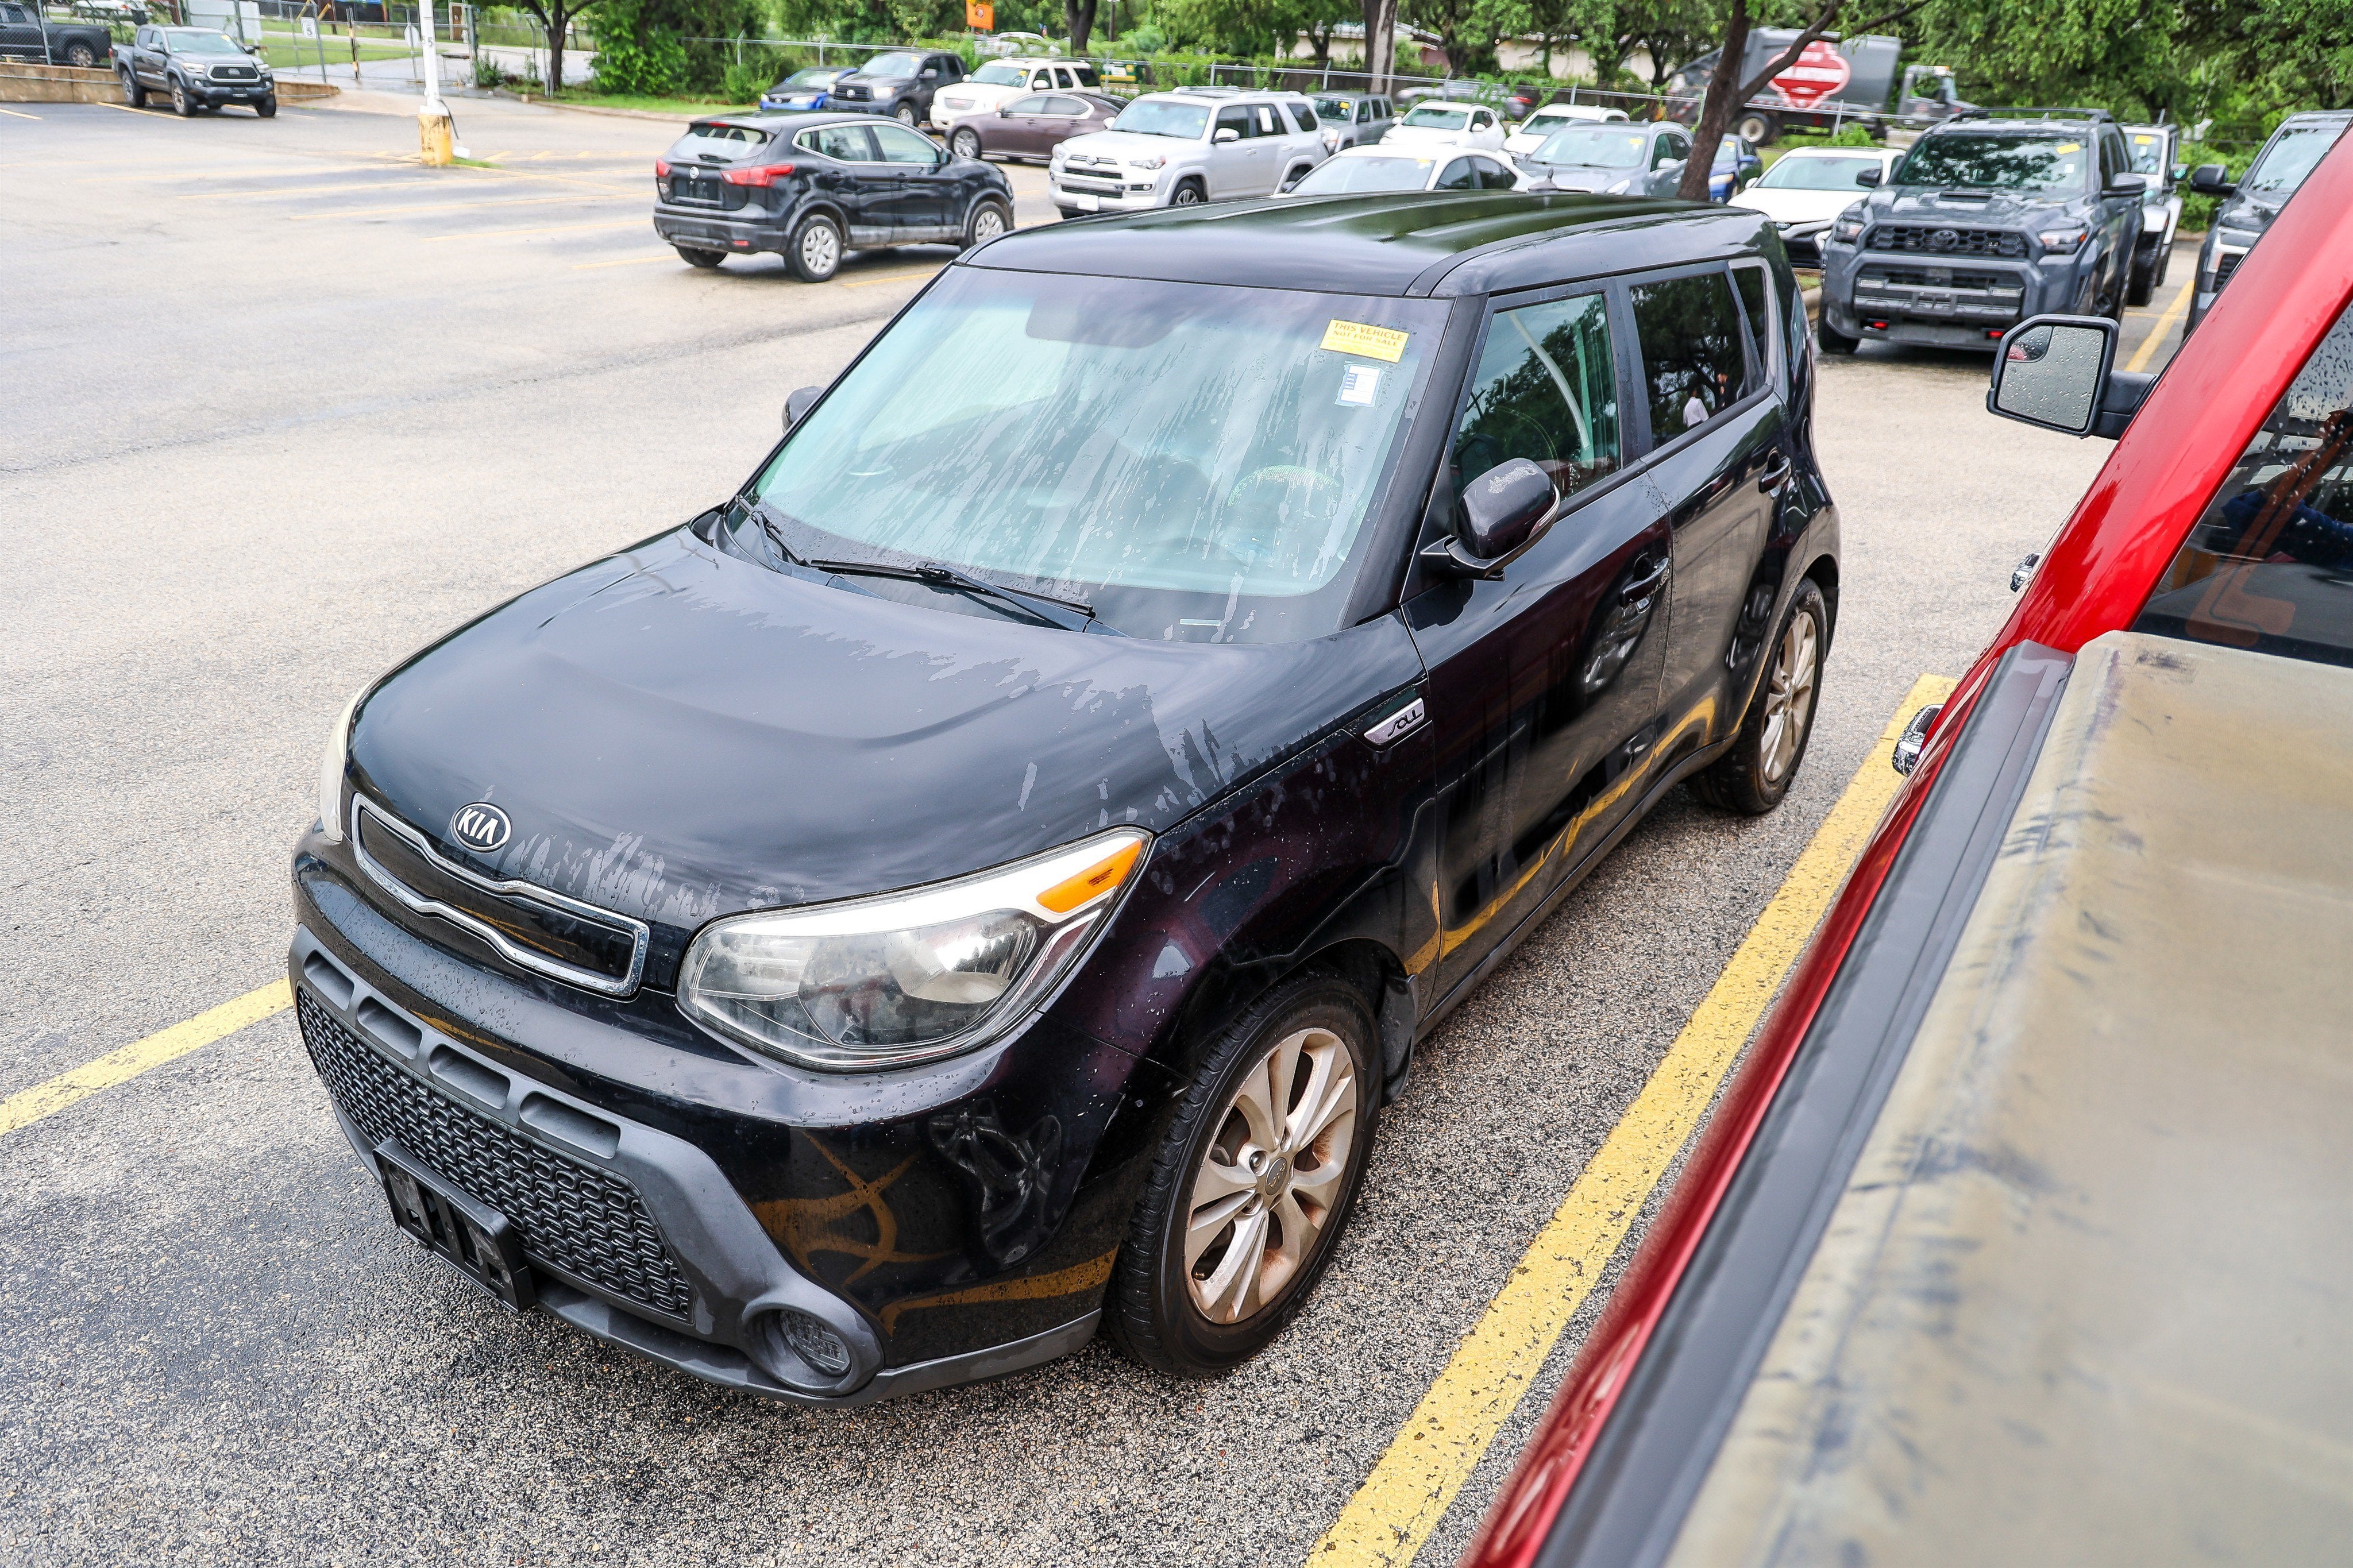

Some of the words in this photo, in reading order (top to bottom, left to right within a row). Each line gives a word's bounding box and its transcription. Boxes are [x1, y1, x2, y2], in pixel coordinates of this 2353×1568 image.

[1334, 322, 1356, 332] THIS
[1360, 326, 1404, 341] VEHICLE
[1375, 338, 1399, 347] SALE
[457, 808, 499, 845] KIA
